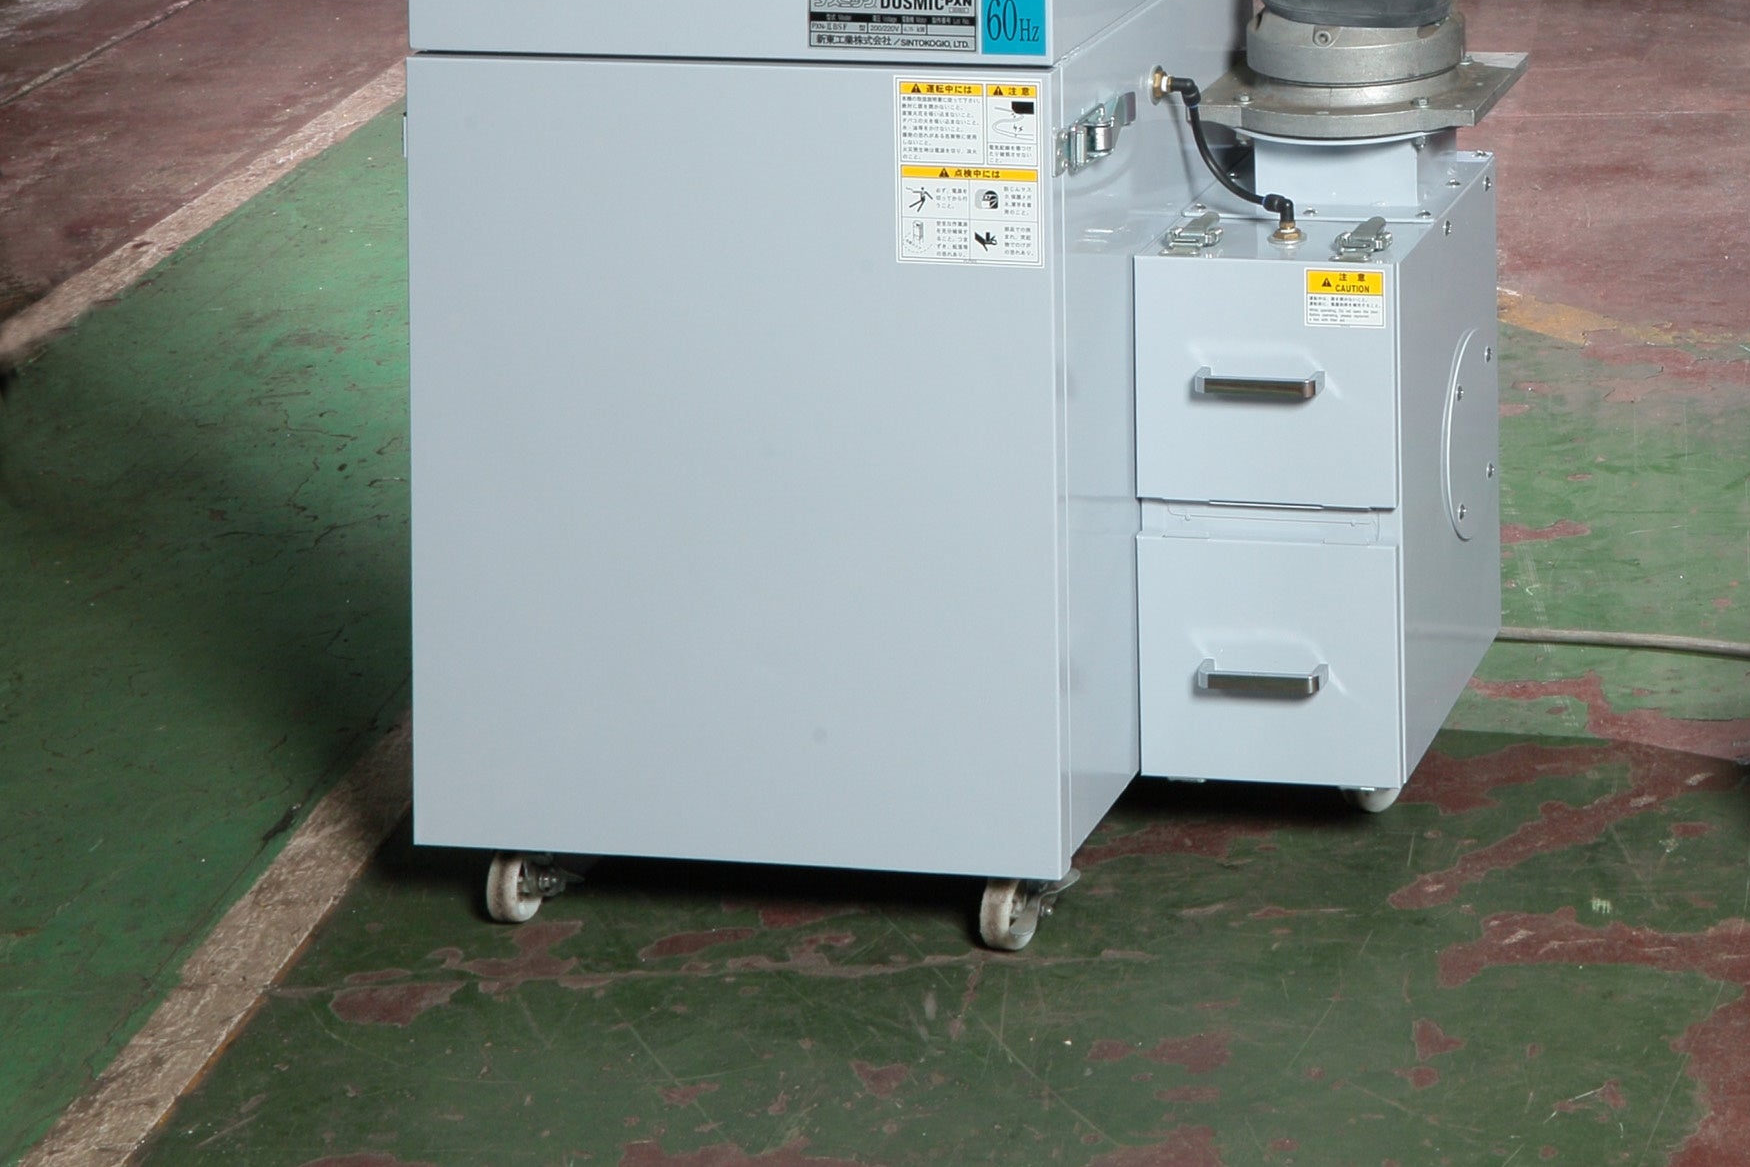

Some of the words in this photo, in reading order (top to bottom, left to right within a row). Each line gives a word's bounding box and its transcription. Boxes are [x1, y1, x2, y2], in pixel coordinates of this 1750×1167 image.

[816, 34, 892, 46] 新東工業株式会社
[926, 84, 972, 94] 運転中には
[954, 168, 1001, 179] 点検中には
[1339, 273, 1366, 282] 注意
[1335, 284, 1370, 293] CAUTION
